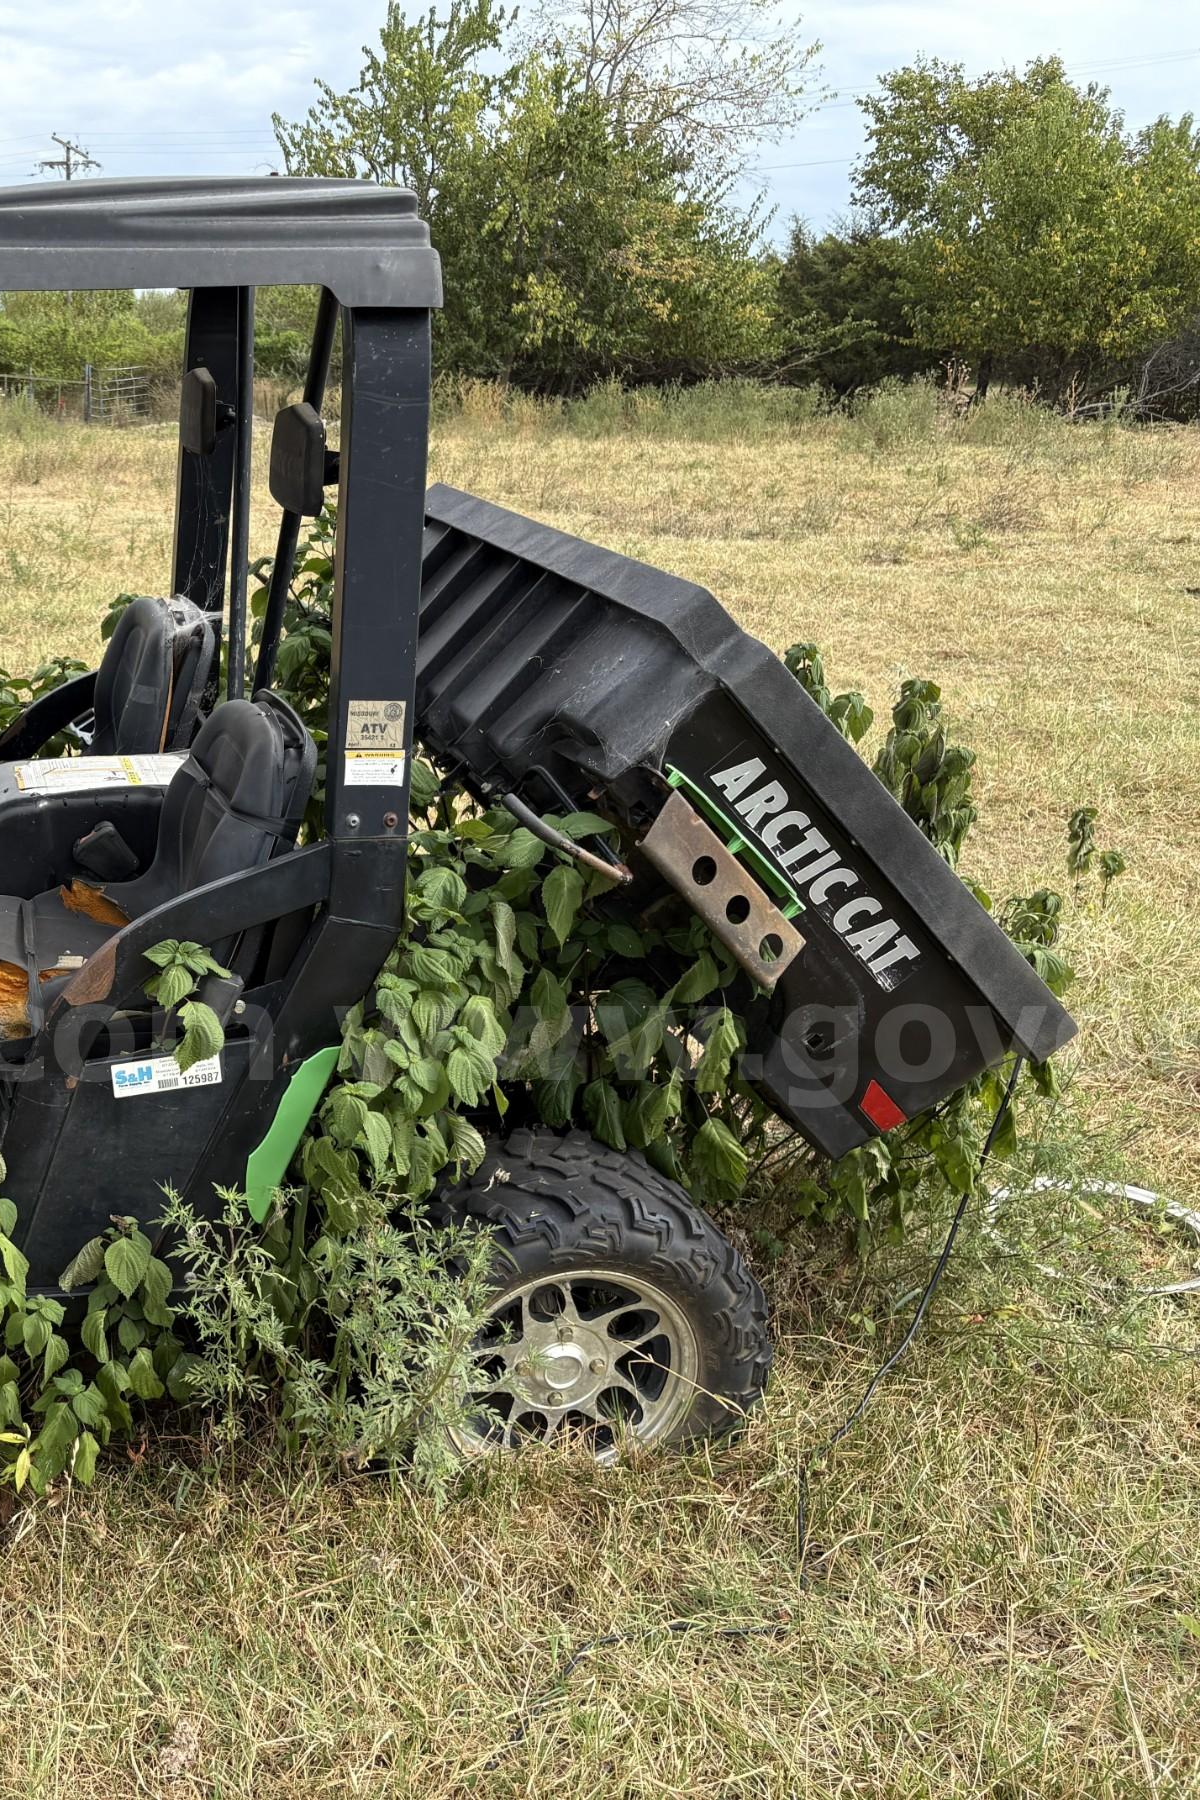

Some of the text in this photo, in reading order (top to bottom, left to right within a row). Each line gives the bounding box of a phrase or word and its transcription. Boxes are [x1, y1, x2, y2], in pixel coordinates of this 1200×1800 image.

[360, 723, 388, 734] ATV
[709, 756, 922, 974] ARCTIC CAT
[114, 1065, 153, 1085] S&H
[182, 1071, 220, 1086] 125987
